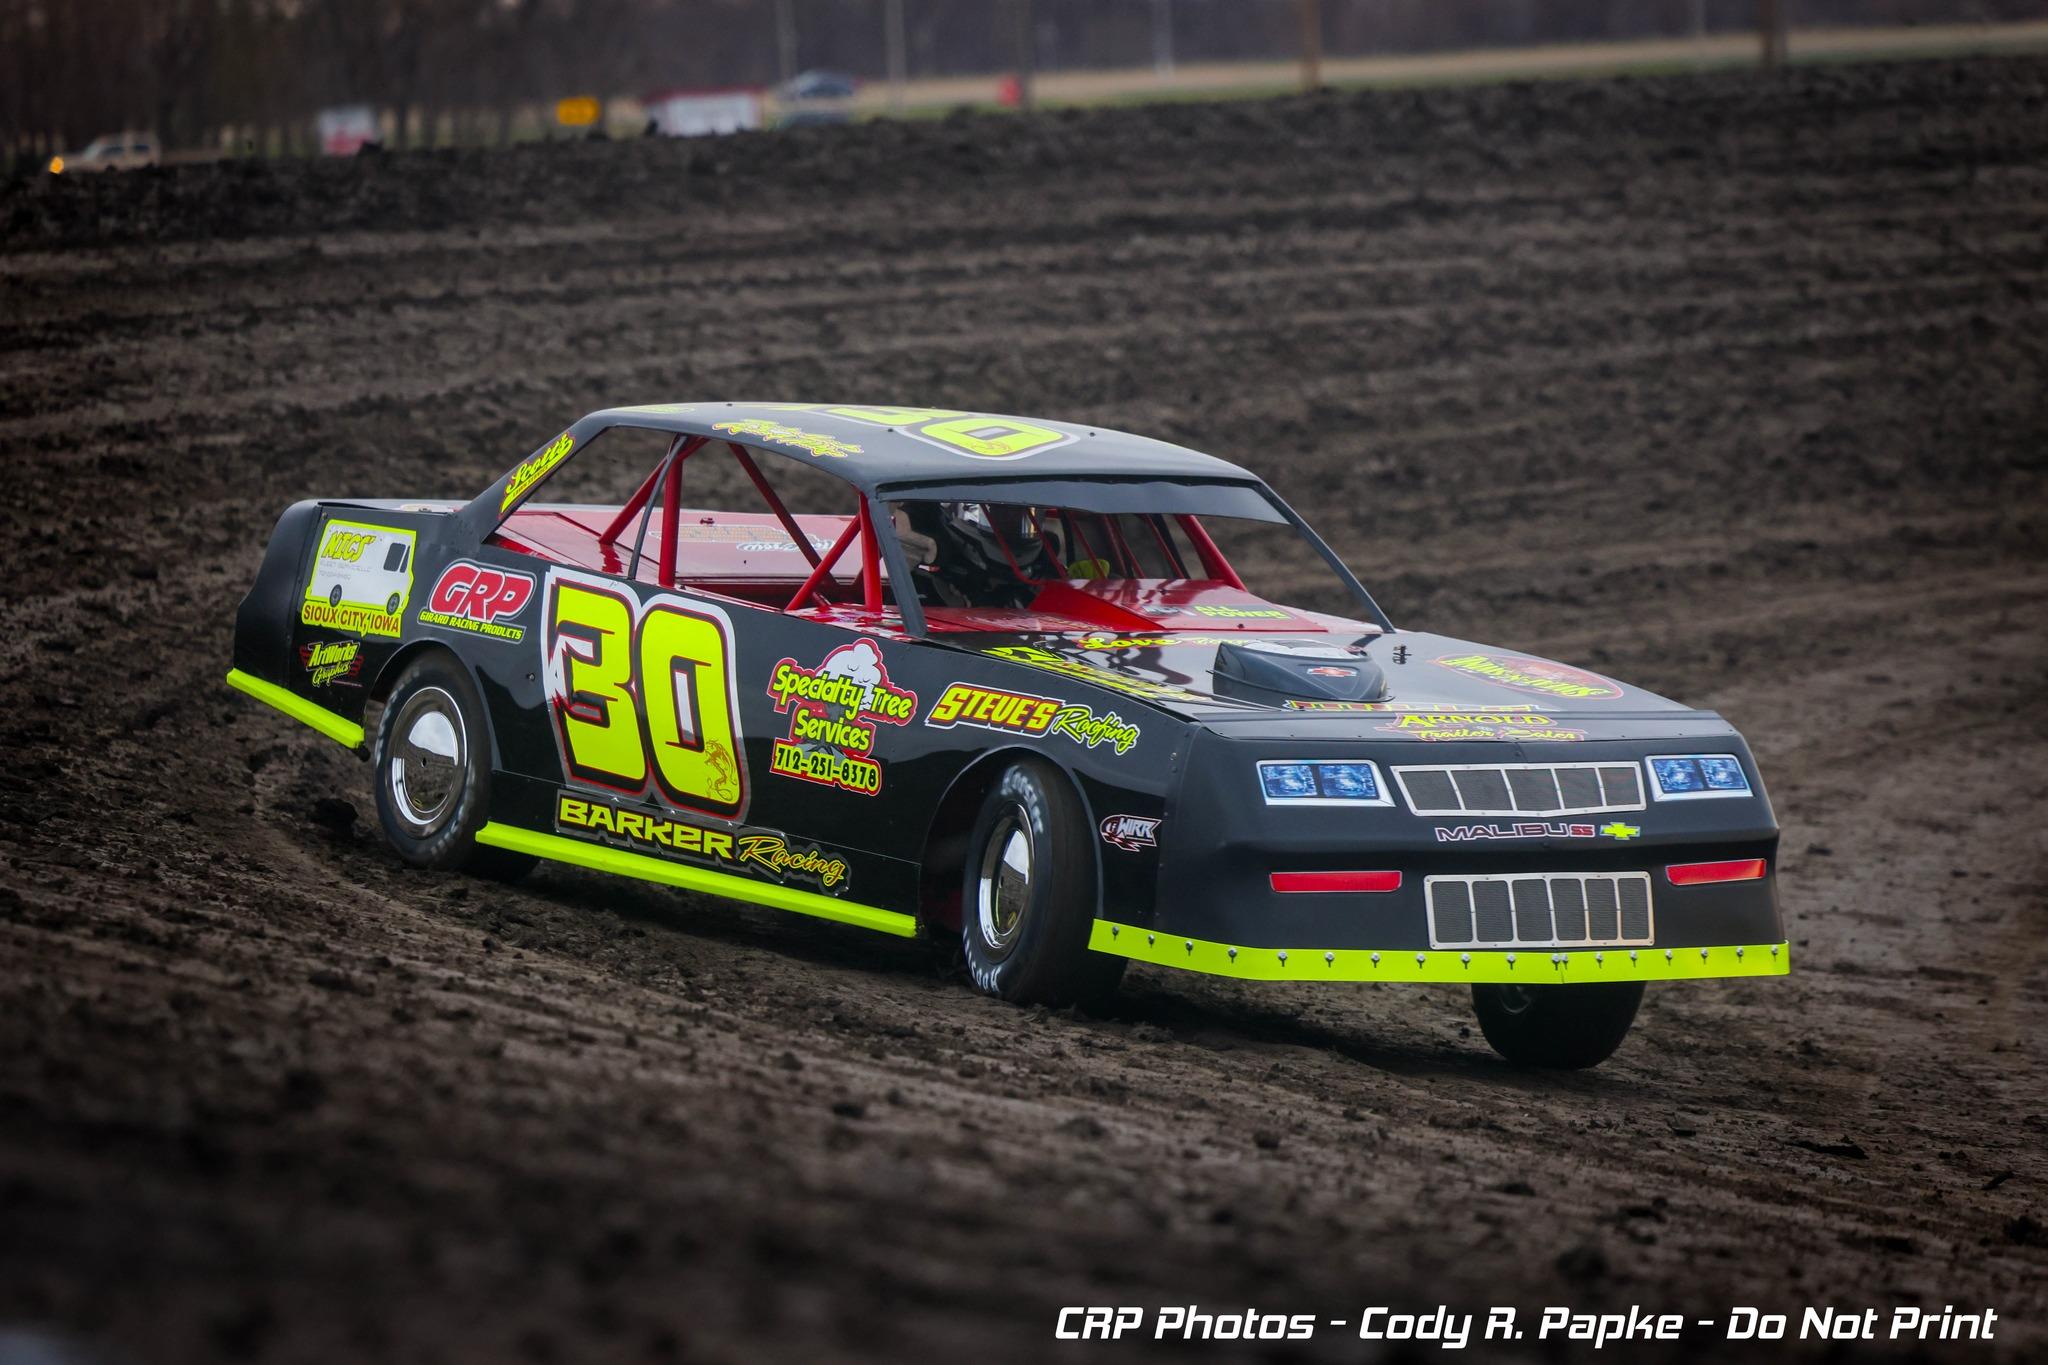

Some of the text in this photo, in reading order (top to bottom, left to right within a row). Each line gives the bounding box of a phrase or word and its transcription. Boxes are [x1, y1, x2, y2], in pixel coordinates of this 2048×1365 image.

[430, 563, 534, 625] GRP
[303, 604, 399, 632] SIOUX CITY, IOWA
[420, 611, 523, 640] GIRARD RACING PRODUCTS
[548, 575, 746, 815] 30
[773, 664, 913, 720] Specialty Tree
[794, 708, 871, 751] Services
[928, 686, 1139, 752] STEVE'S Roofing
[1398, 714, 1551, 728] ARNOLD
[1408, 730, 1495, 741] Trailer
[776, 747, 878, 789] 712-251-8378
[559, 797, 847, 887] BARKER Racing
[1434, 823, 1596, 842] MALIBU SS
